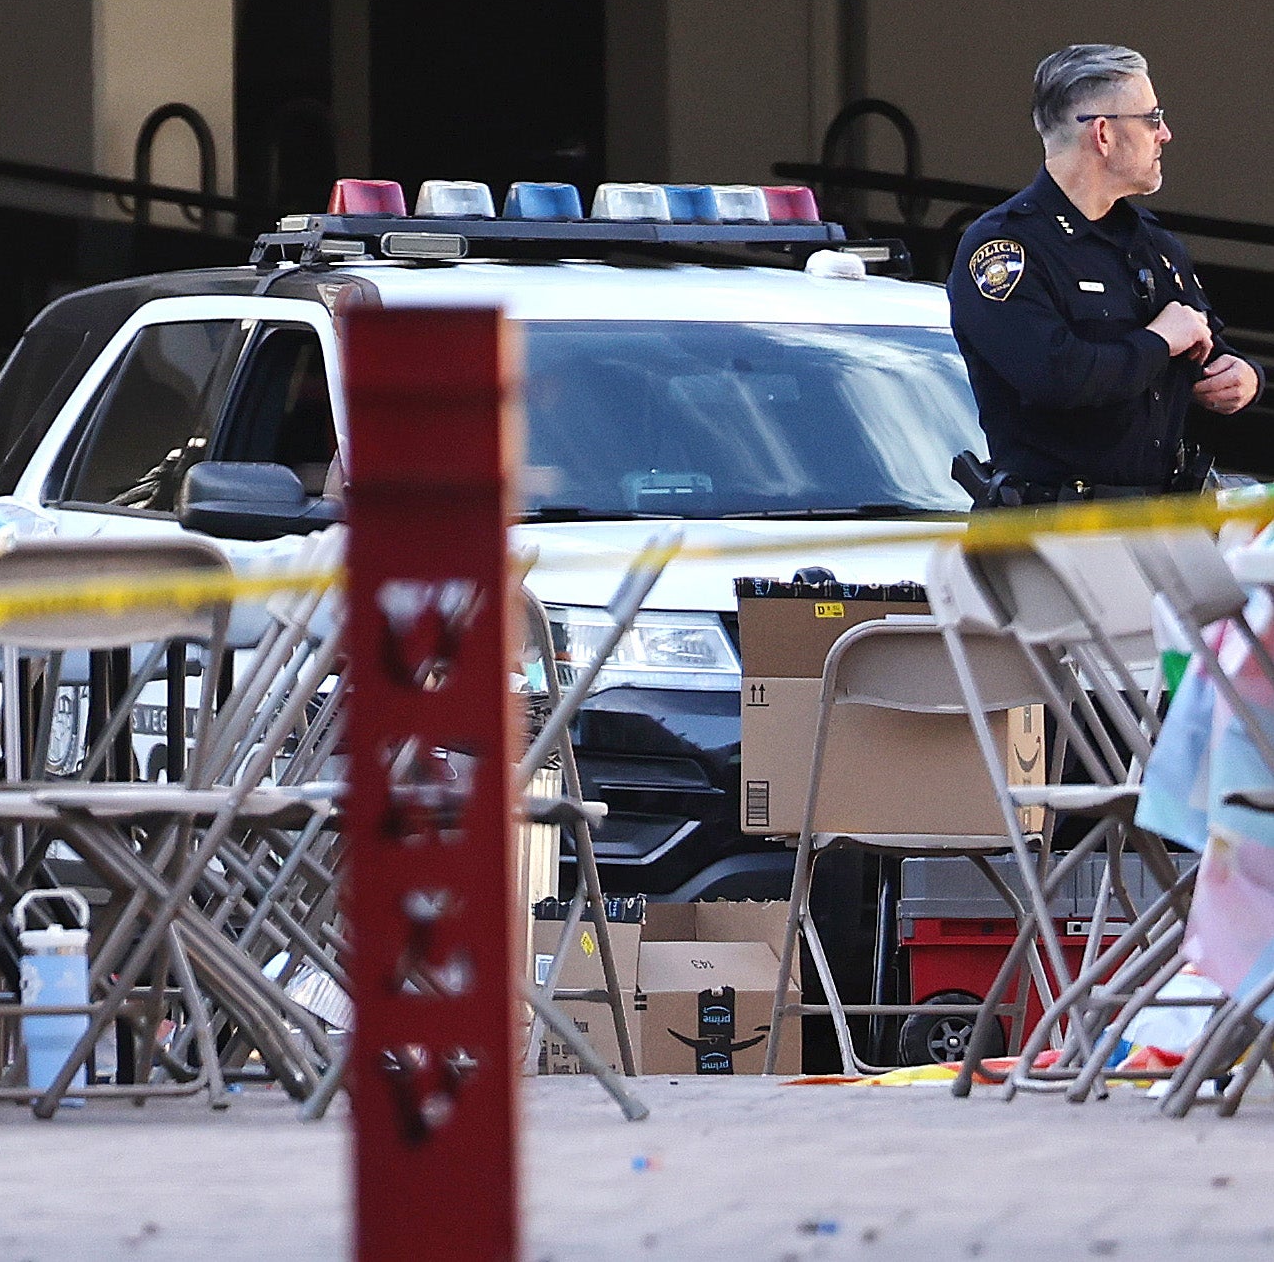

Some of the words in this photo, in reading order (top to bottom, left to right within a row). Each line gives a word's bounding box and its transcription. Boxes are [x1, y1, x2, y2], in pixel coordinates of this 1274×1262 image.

[970, 242, 1020, 273] POLICE
[143, 710, 168, 732] VEG
[703, 1013, 731, 1025] prime
[701, 1059, 729, 1071] prime
